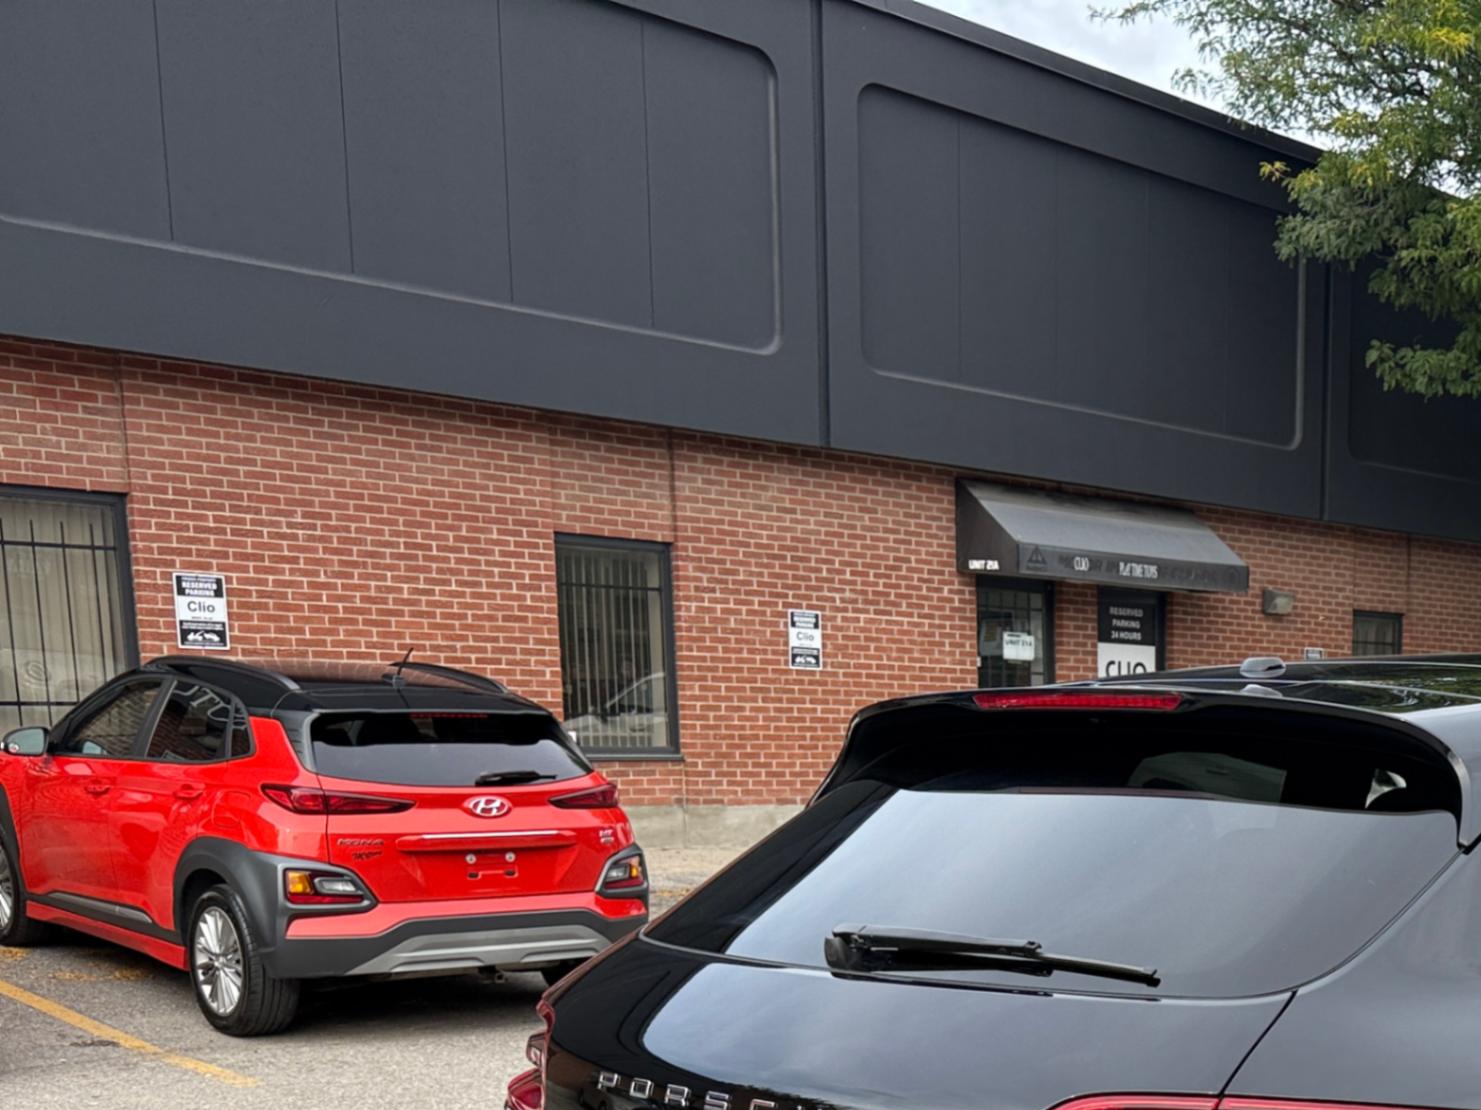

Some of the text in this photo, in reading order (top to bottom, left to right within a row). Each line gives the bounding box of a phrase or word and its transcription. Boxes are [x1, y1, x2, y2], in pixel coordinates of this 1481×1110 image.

[182, 581, 217, 590] RESERVED
[185, 588, 215, 597] PARKING
[187, 600, 216, 613] Clio
[1109, 606, 1143, 617] RESERVED
[1112, 618, 1140, 629] PARKING
[1120, 631, 1141, 640] HOURS
